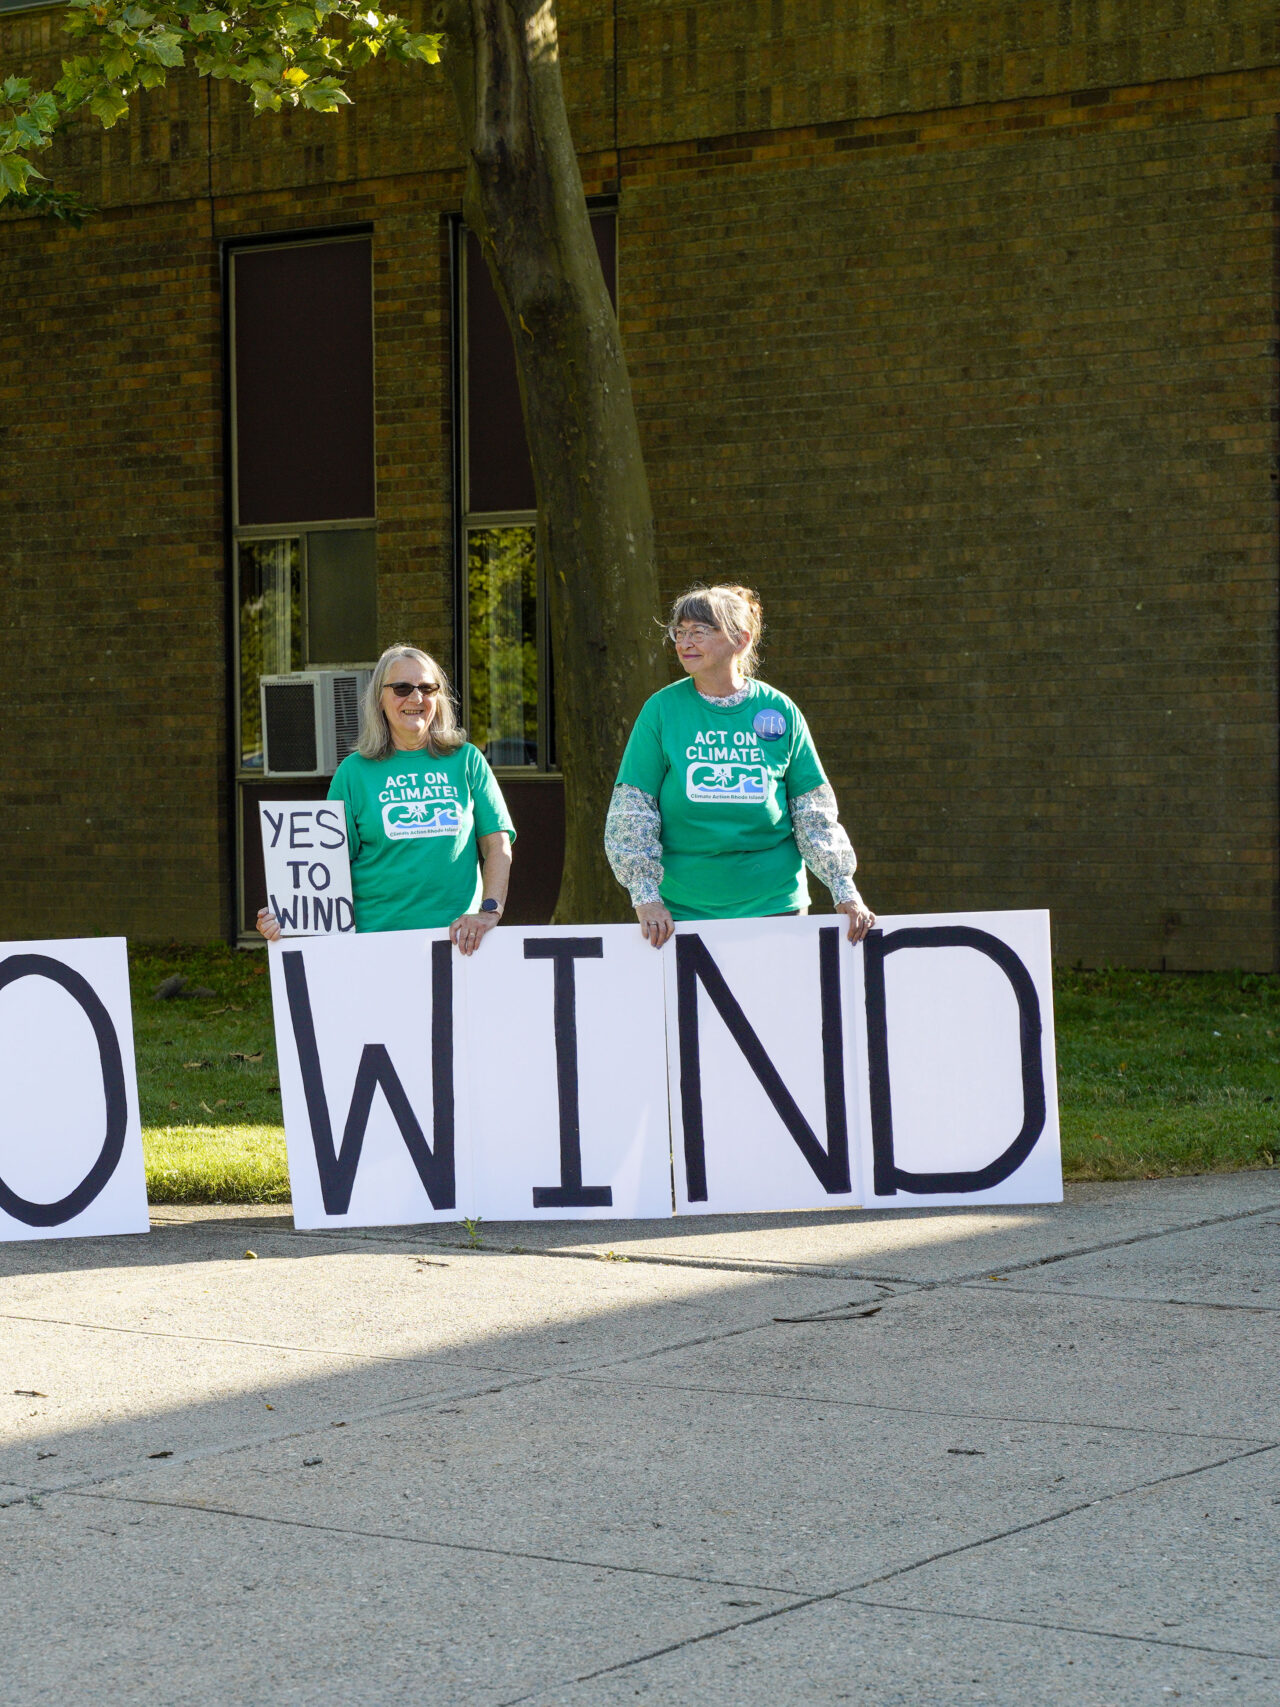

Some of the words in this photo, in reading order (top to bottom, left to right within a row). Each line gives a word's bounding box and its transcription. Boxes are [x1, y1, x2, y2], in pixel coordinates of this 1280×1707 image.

[759, 715, 784, 735] YES
[694, 731, 728, 745] ACT
[733, 731, 757, 746] ON
[686, 746, 766, 762] CLIMATE!
[385, 773, 418, 789] ACT
[424, 772, 448, 785] ON
[378, 786, 458, 803] CLIMATE!
[263, 809, 345, 849] YES
[287, 861, 331, 891] TO
[270, 894, 356, 932] WIND
[281, 925, 1046, 1216] WIND
